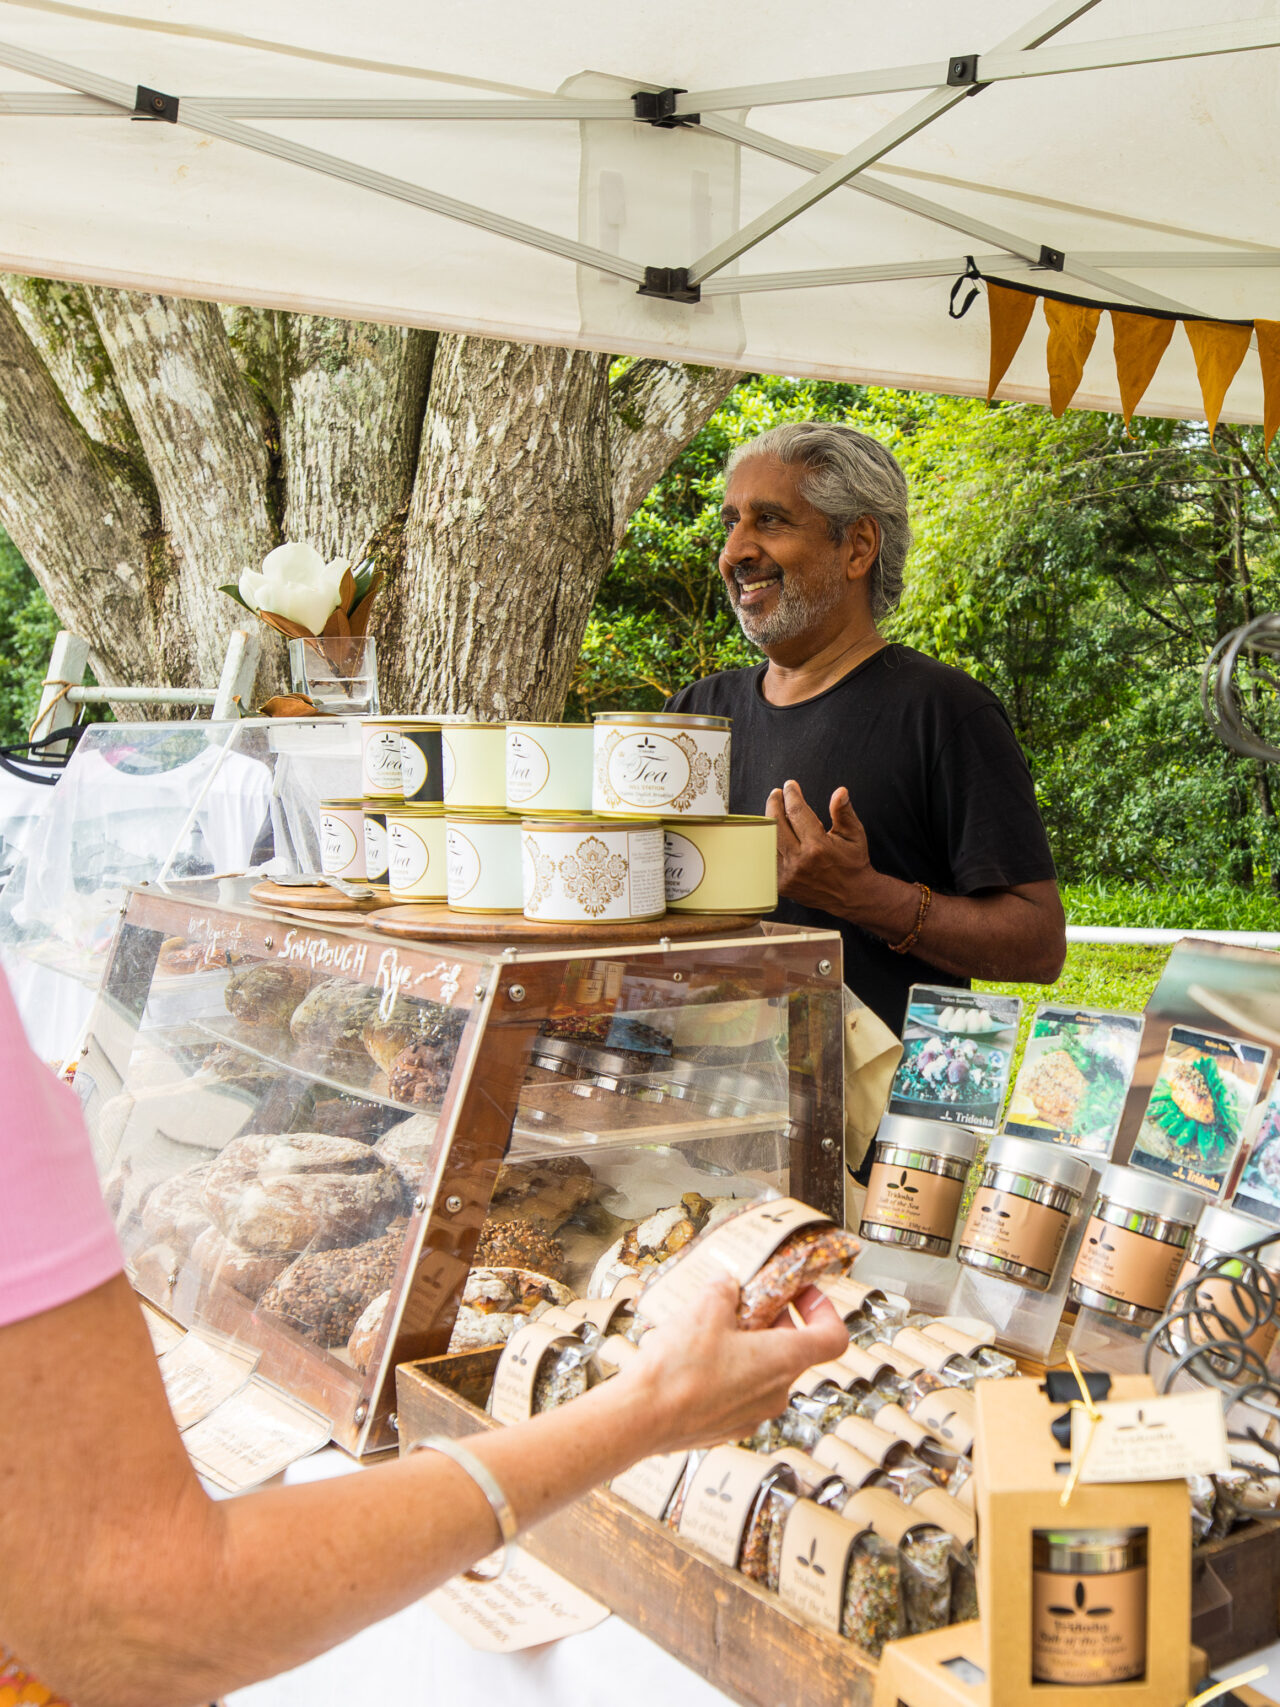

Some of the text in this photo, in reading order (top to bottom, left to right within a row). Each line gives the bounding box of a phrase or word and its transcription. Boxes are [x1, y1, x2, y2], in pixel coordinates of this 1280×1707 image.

[956, 1112, 994, 1127] Tridosha
[1186, 1169, 1220, 1192] Tridosha
[887, 1190, 915, 1202] Tridosha
